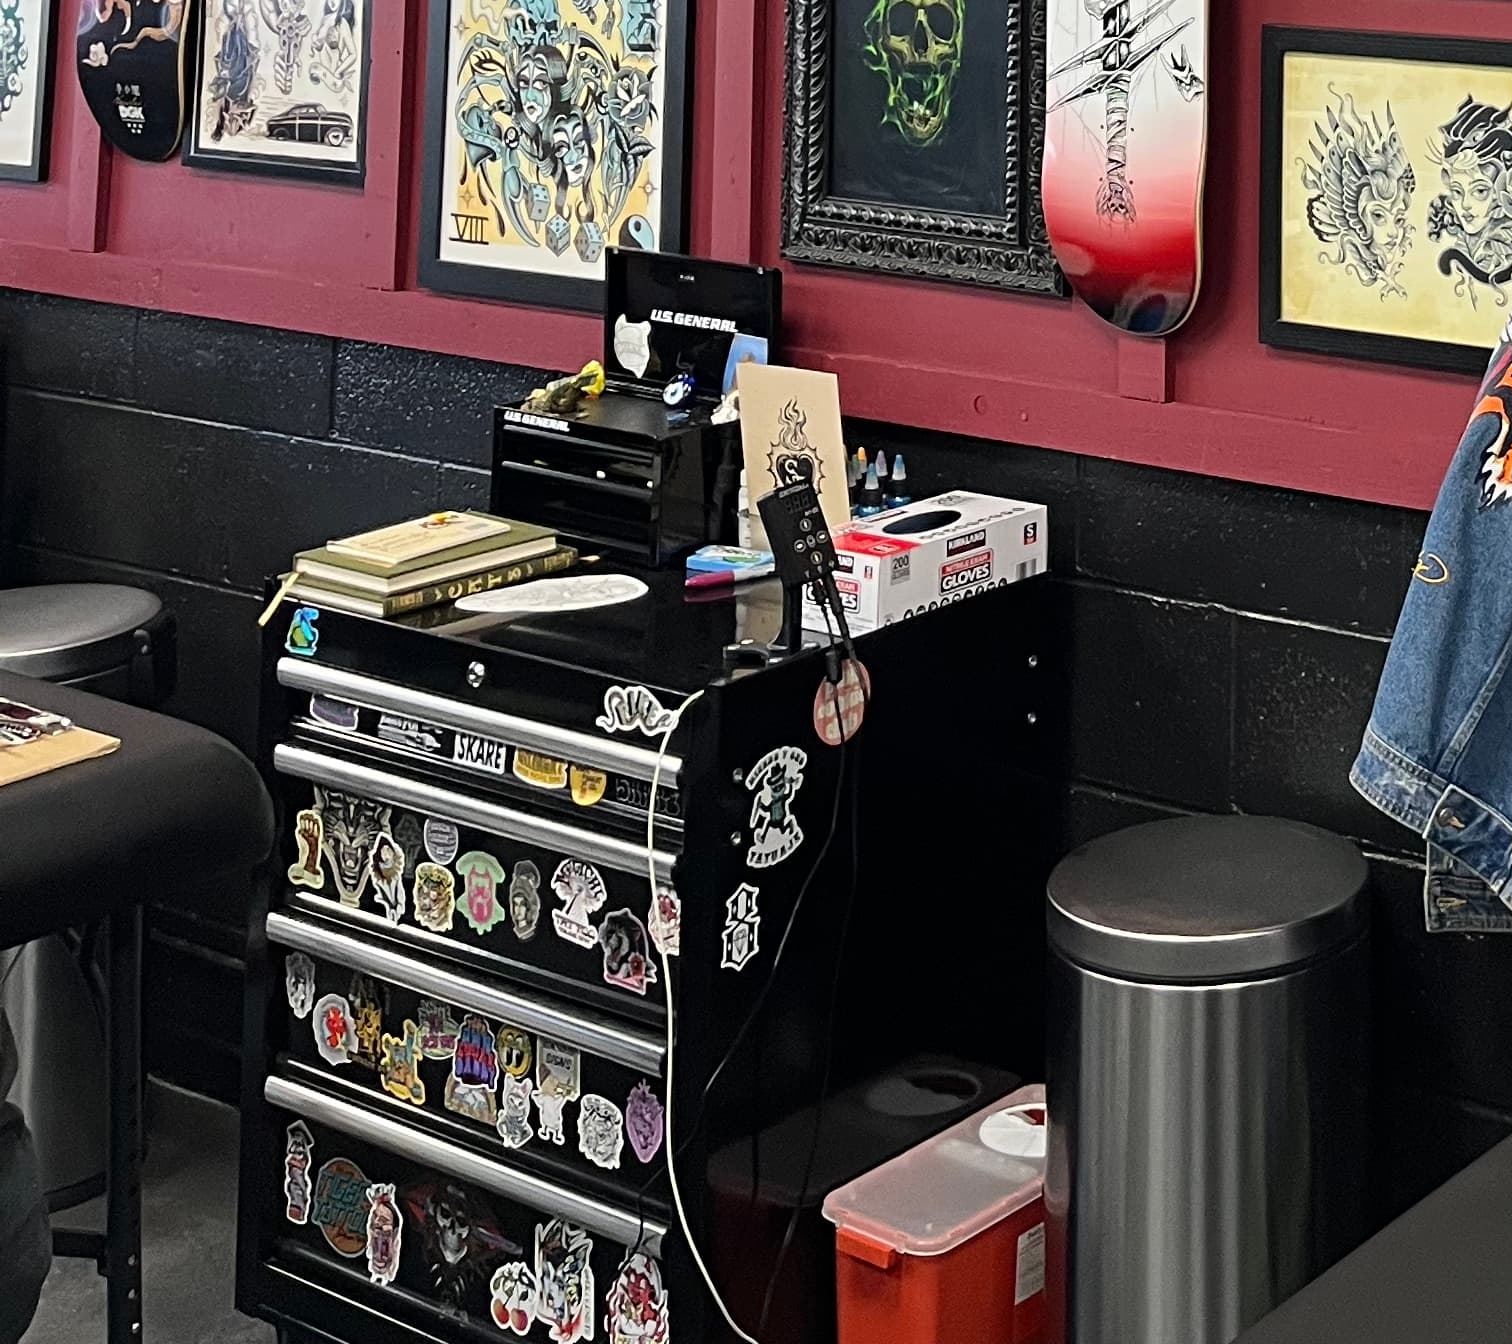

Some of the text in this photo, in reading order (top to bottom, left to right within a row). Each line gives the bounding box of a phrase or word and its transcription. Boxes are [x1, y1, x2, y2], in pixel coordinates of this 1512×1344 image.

[119, 105, 145, 120] DGK
[449, 212, 489, 245] VIII
[674, 311, 738, 334] GENERAL
[521, 413, 570, 433] GENERAL
[1026, 523, 1034, 537] S
[892, 555, 910, 569] 200
[941, 565, 990, 590] GLOVES
[458, 733, 504, 769] SKARE
